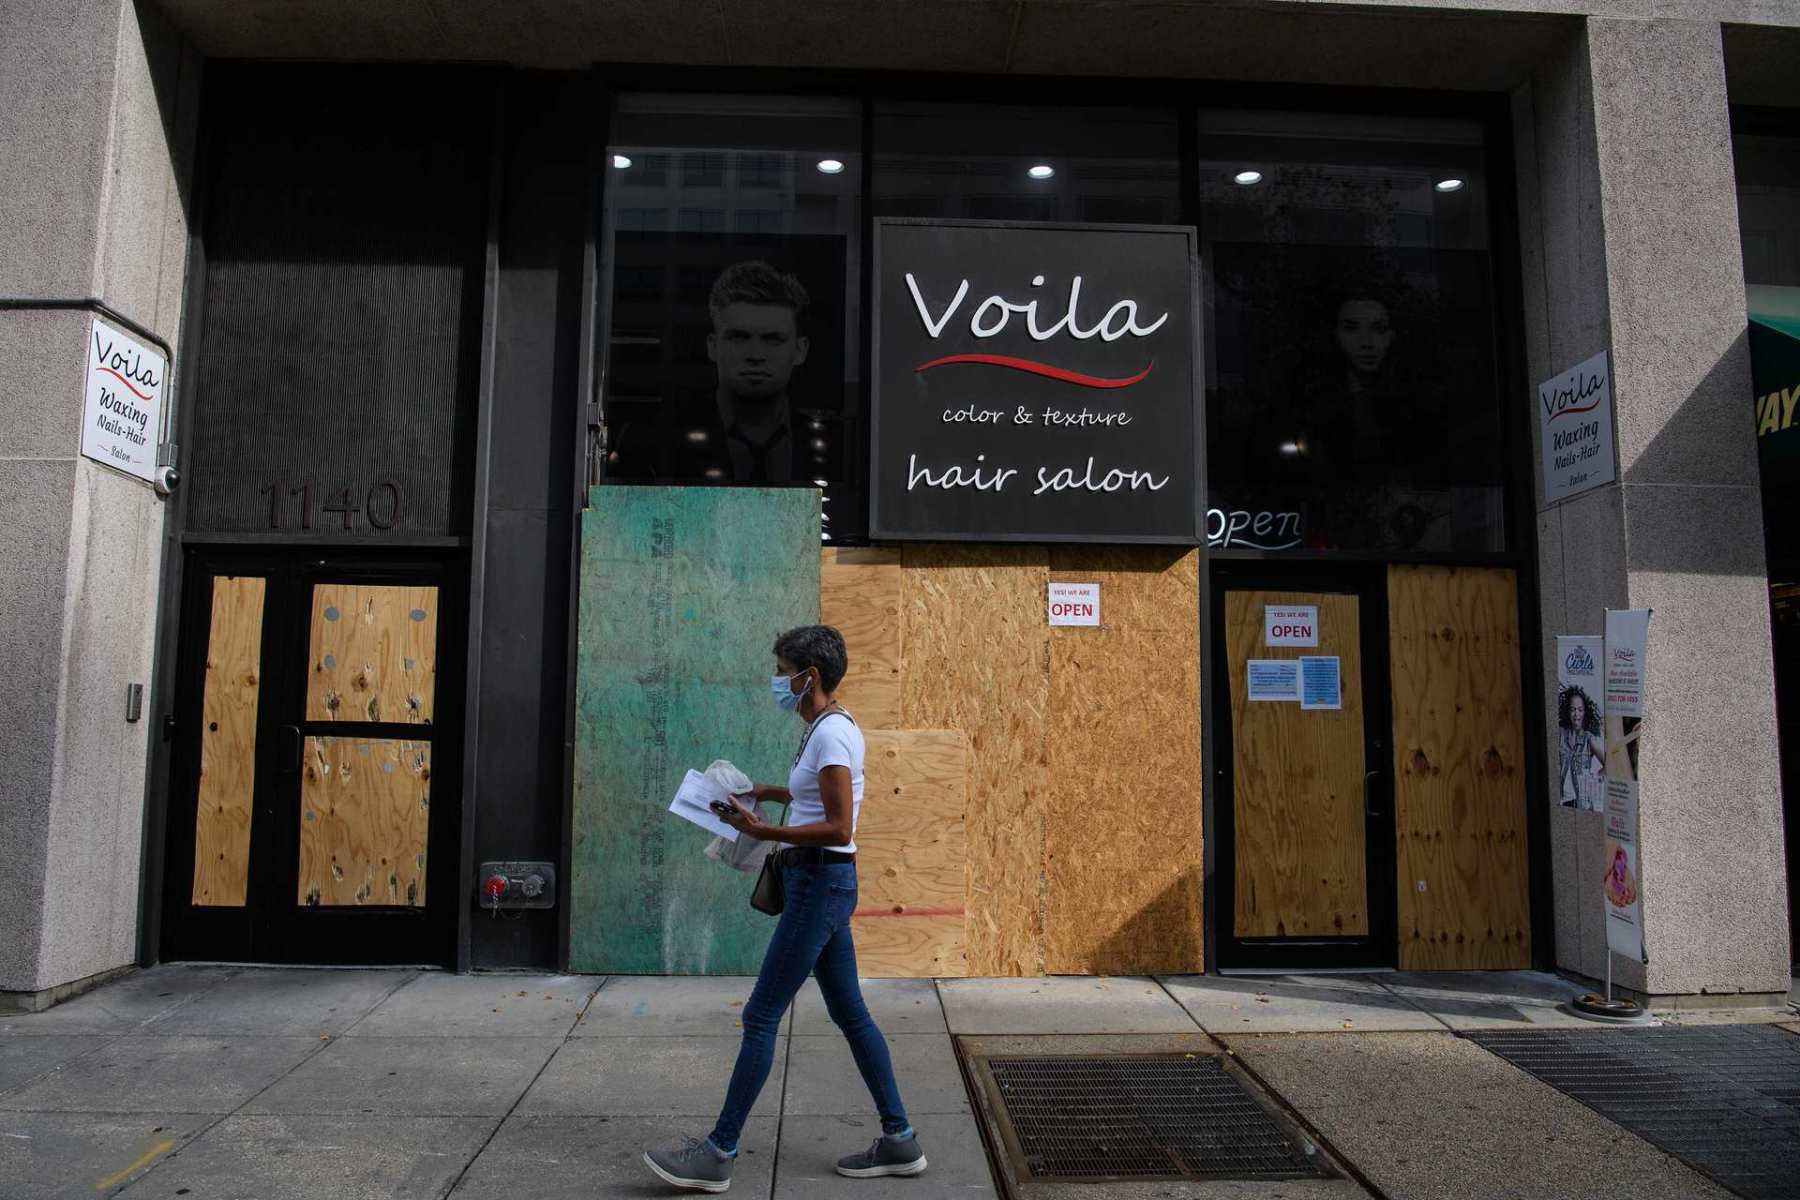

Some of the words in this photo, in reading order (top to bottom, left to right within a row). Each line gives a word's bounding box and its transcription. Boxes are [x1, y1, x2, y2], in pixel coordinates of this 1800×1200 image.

[906, 272, 1168, 342] Voila
[96, 331, 159, 388] Voila
[100, 387, 148, 431] Waxing
[1542, 372, 1605, 416] Voila
[97, 414, 147, 446] Nails-Hair
[942, 404, 1005, 424] color
[1013, 405, 1033, 425] &
[1042, 406, 1134, 427] texture
[1553, 420, 1600, 451] Waxing
[907, 453, 1018, 491] hair
[1033, 456, 1170, 495] salon
[1554, 443, 1601, 471] Nails-Hair
[261, 479, 402, 530] 1140
[1207, 508, 1301, 548] Open
[1051, 603, 1093, 617] OPEN
[1272, 625, 1312, 638] OPEN
[1565, 653, 1594, 670] Curls
